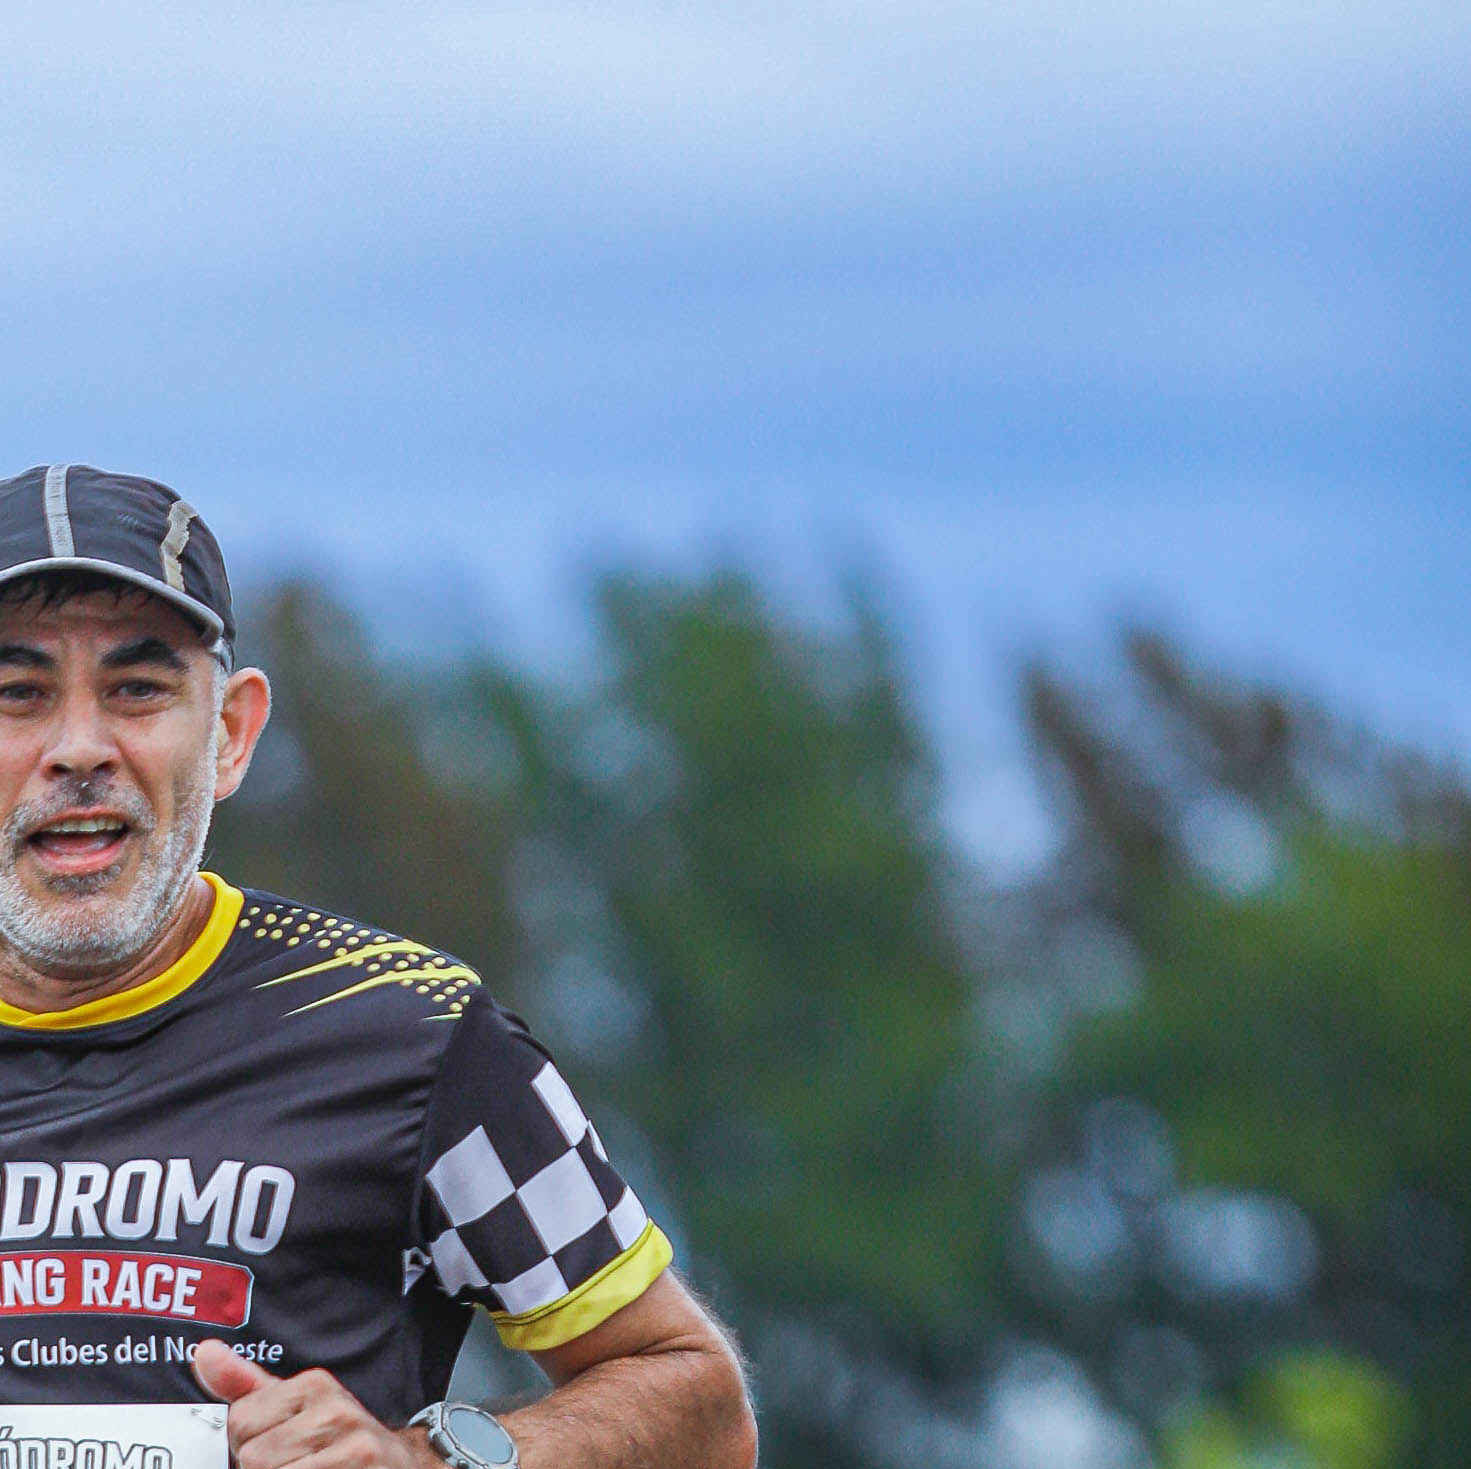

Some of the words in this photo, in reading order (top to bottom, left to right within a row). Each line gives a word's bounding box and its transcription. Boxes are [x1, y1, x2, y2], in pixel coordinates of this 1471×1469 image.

[81, 1257, 204, 1318] RACE
[11, 1337, 108, 1367] Clubes
[114, 1335, 157, 1364] del
[164, 1336, 283, 1364] Noeste
